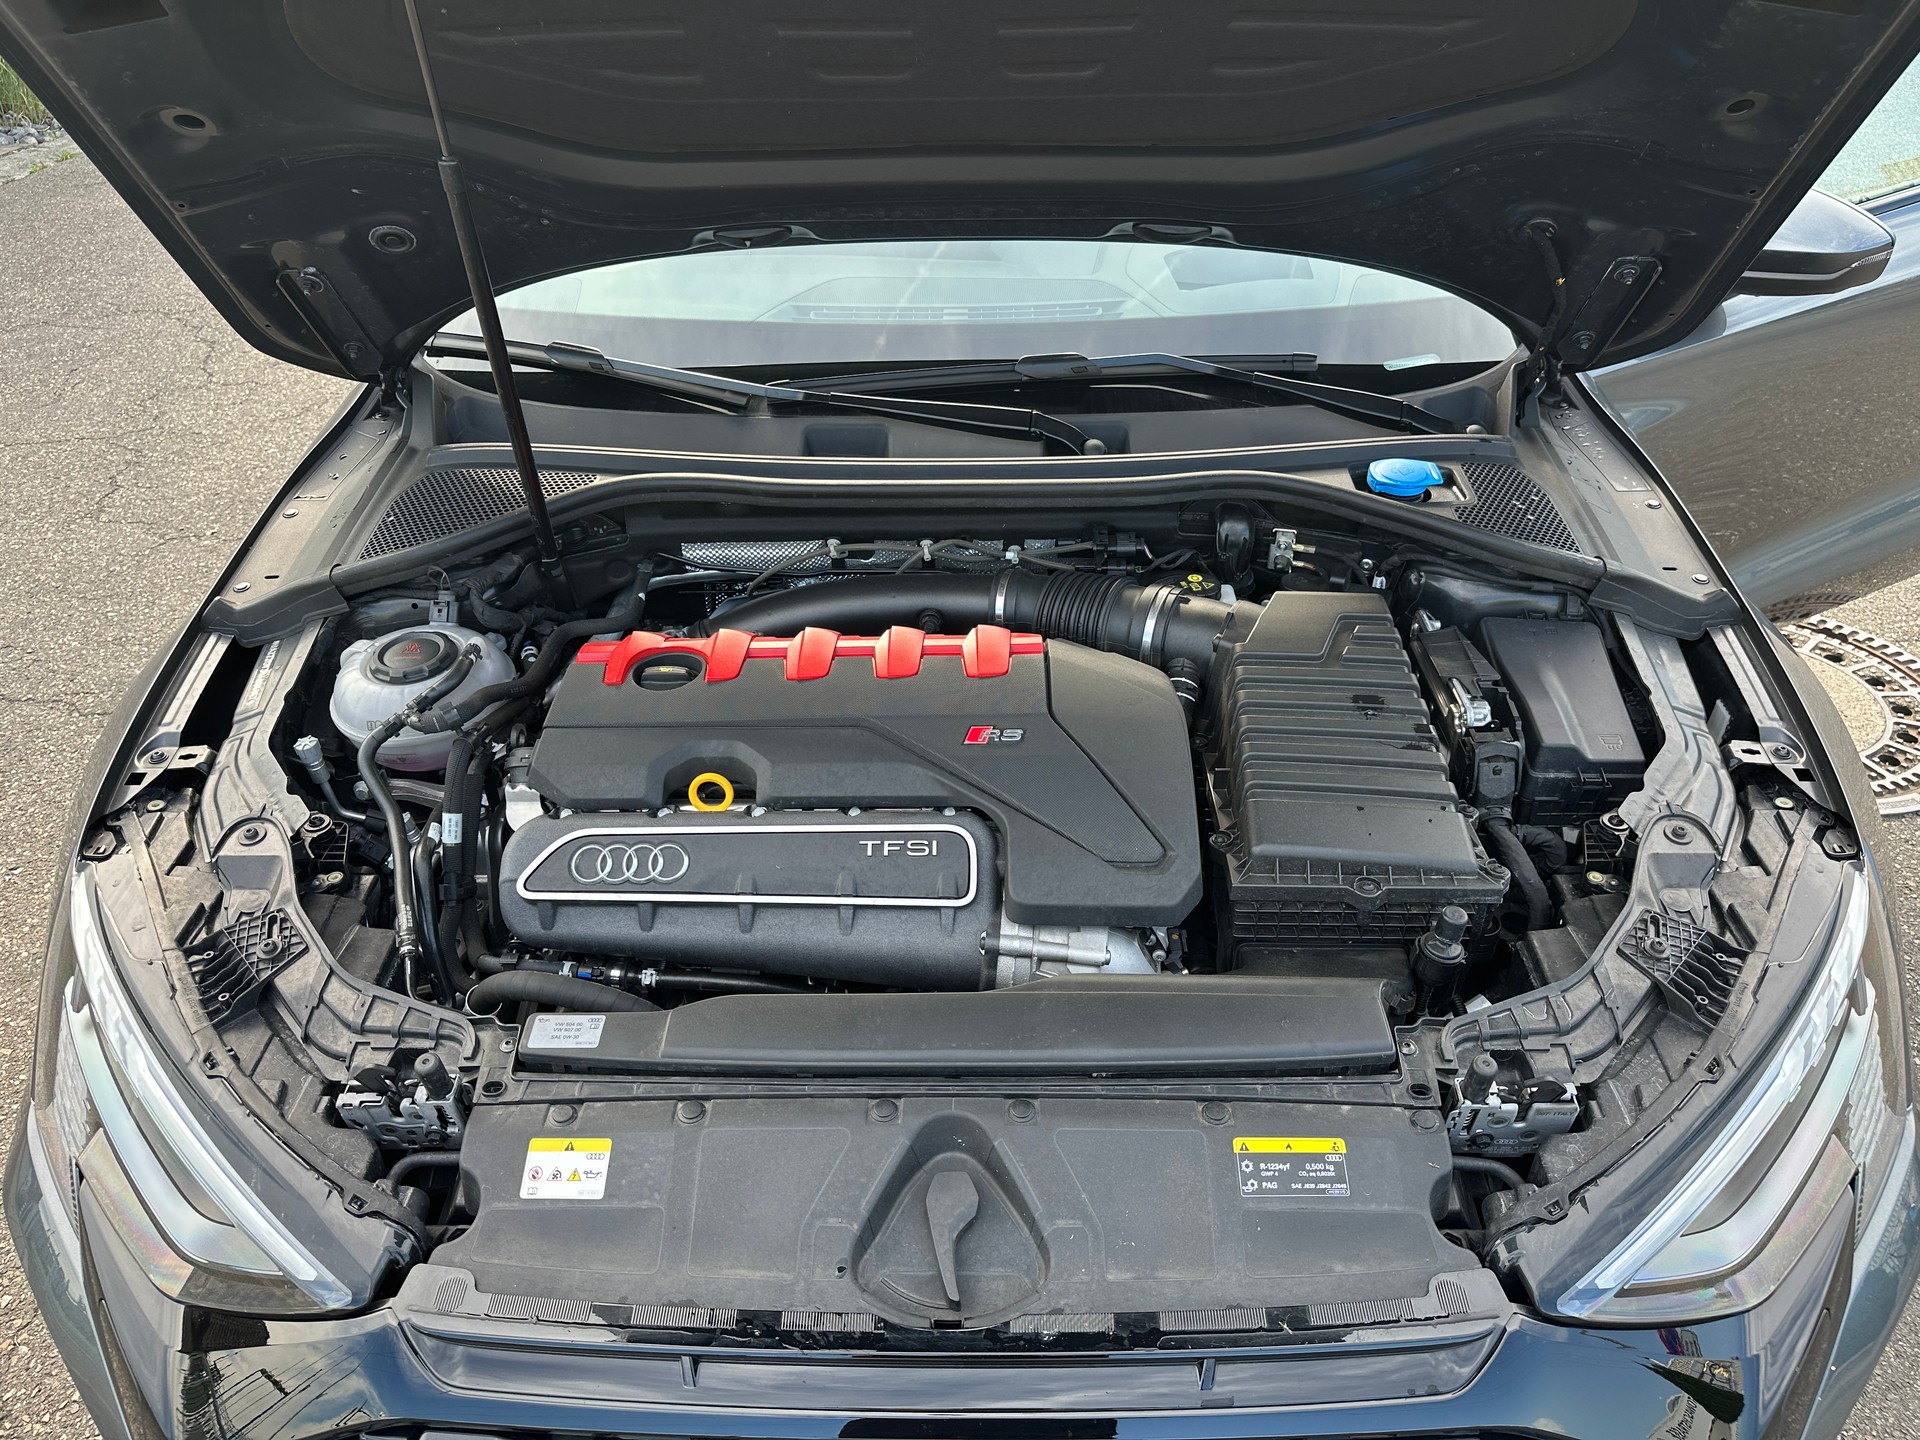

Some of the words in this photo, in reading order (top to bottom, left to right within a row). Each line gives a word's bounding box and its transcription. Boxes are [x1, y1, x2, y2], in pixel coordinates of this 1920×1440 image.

[975, 728, 1024, 742] RS
[859, 840, 937, 856] TFSI
[1260, 1163, 1290, 1171] R-1234yf
[1325, 1163, 1335, 1171] kg
